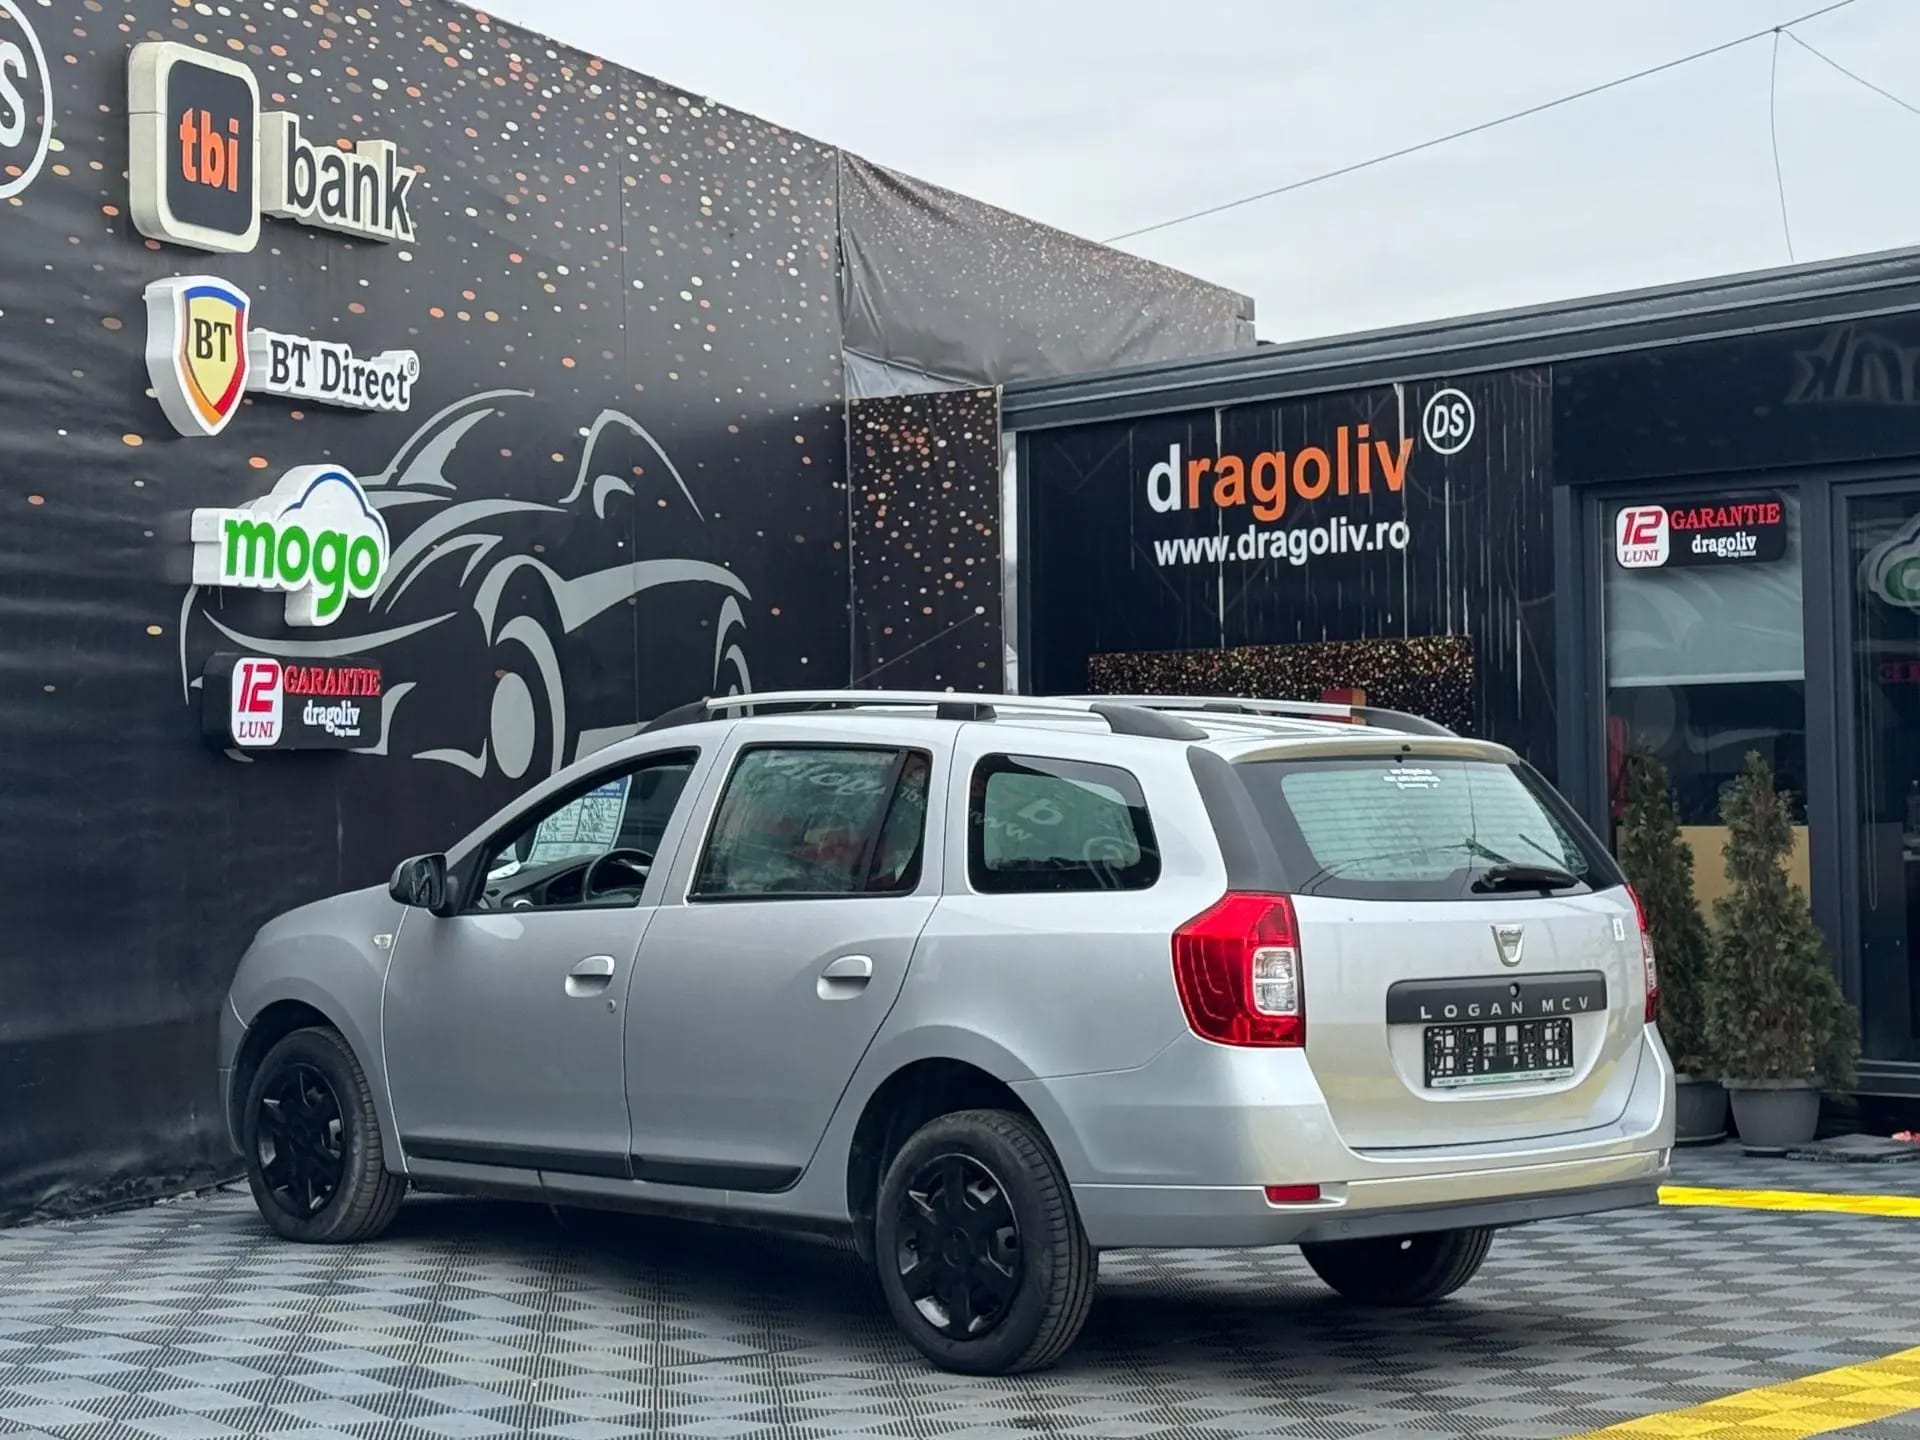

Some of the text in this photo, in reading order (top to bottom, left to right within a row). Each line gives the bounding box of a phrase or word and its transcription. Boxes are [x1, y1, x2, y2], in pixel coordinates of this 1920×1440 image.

[179, 107, 412, 234] tbi bank
[194, 318, 232, 362] BT
[270, 340, 310, 388] BT
[1432, 402, 1466, 439] DS
[1147, 424, 1414, 522] dragoliv
[1622, 510, 1663, 546] 12
[1671, 503, 1780, 529] GARANTIE
[1154, 516, 1411, 567] www.dragoliv.ro
[1622, 549, 1660, 563] LUNI
[1691, 531, 1757, 557] dragoliv
[224, 519, 380, 617] mogo
[238, 663, 279, 713] 12
[284, 666, 381, 695] GARANTIE
[238, 721, 275, 739] LUNI
[303, 699, 360, 733] dragoliv
[1420, 996, 1589, 1020] LOGAN MCV
